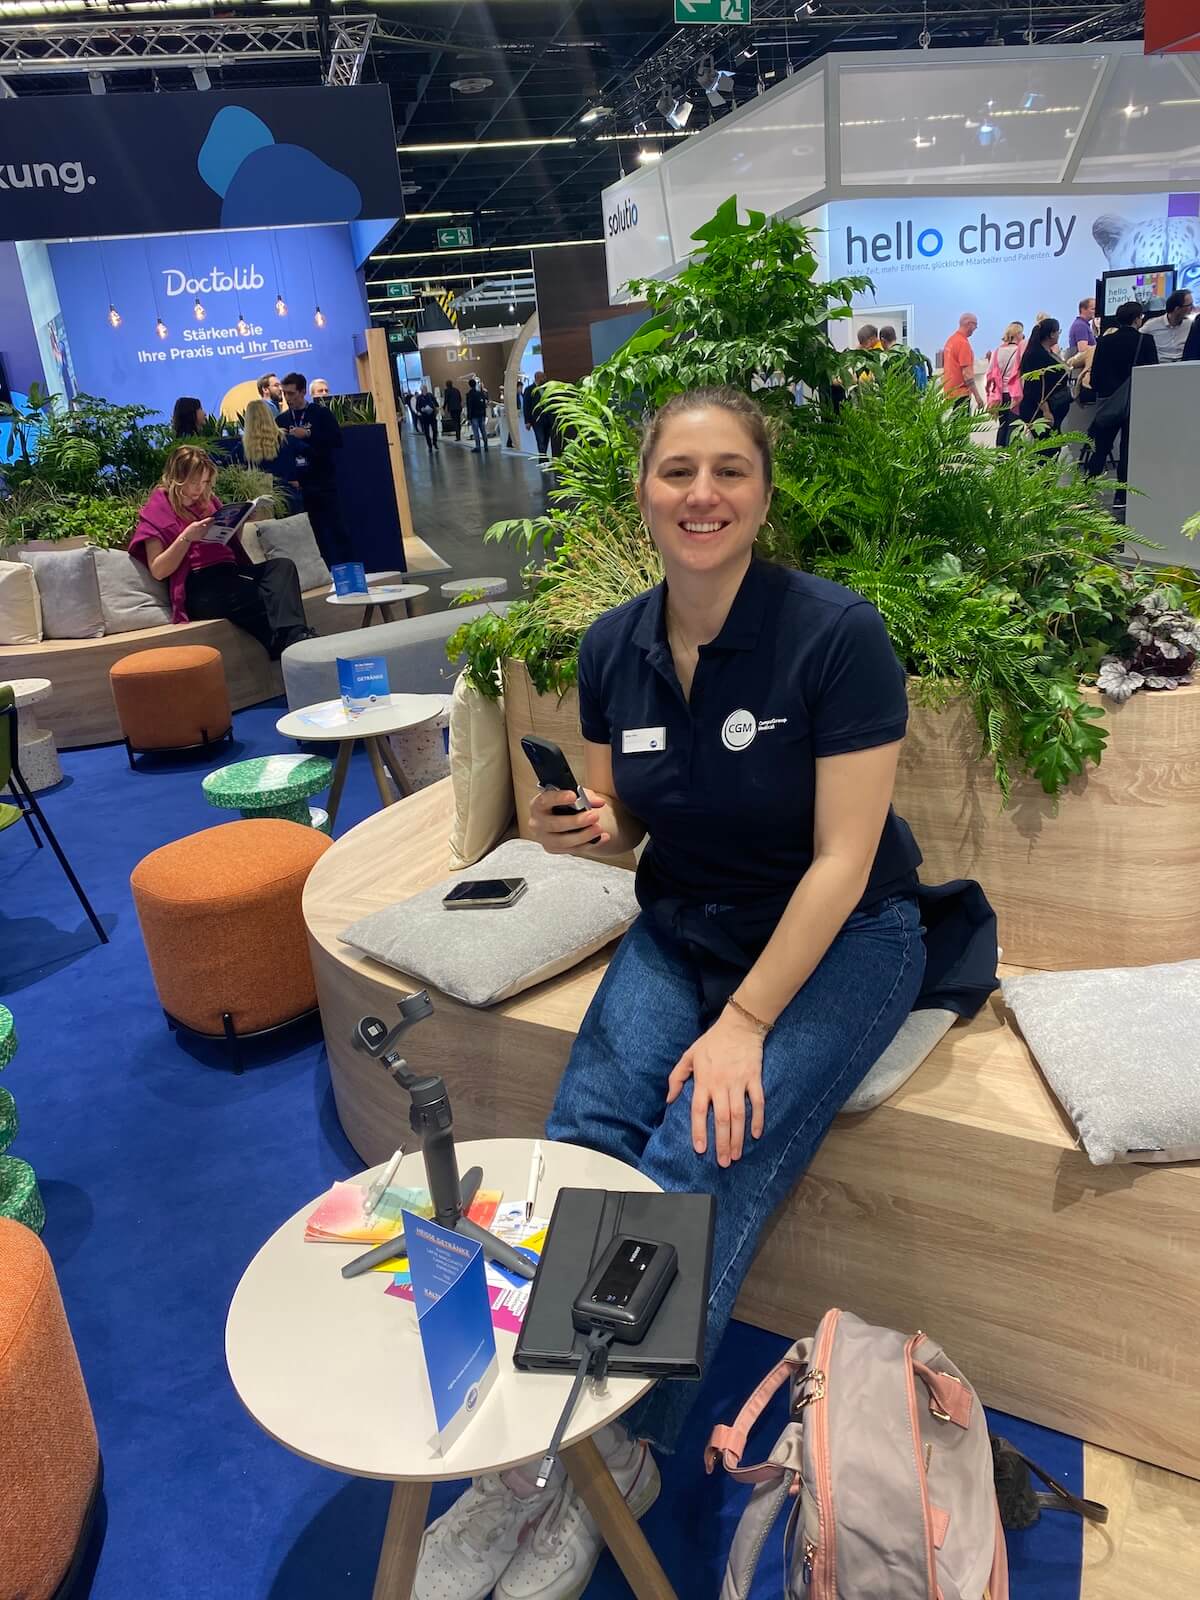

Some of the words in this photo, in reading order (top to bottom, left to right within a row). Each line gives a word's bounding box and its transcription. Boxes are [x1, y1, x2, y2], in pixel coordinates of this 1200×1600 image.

[608, 197, 638, 237] solutio
[846, 220, 944, 265] hello
[959, 206, 1077, 257] charly
[882, 265, 899, 273] mehr
[900, 263, 931, 272] Effizienz,
[966, 256, 1002, 266] Mitarbeiter
[1004, 254, 1016, 262] und
[161, 264, 265, 296] Doctolib
[1107, 294, 1131, 304] charly
[1108, 287, 1128, 296] hello
[183, 326, 239, 342] Stärken
[137, 350, 166, 363] Ihre
[170, 345, 214, 360] Praxis
[217, 342, 245, 355] und
[248, 340, 268, 353] Ihr
[270, 338, 313, 351] Team.
[728, 723, 752, 733] CGM
